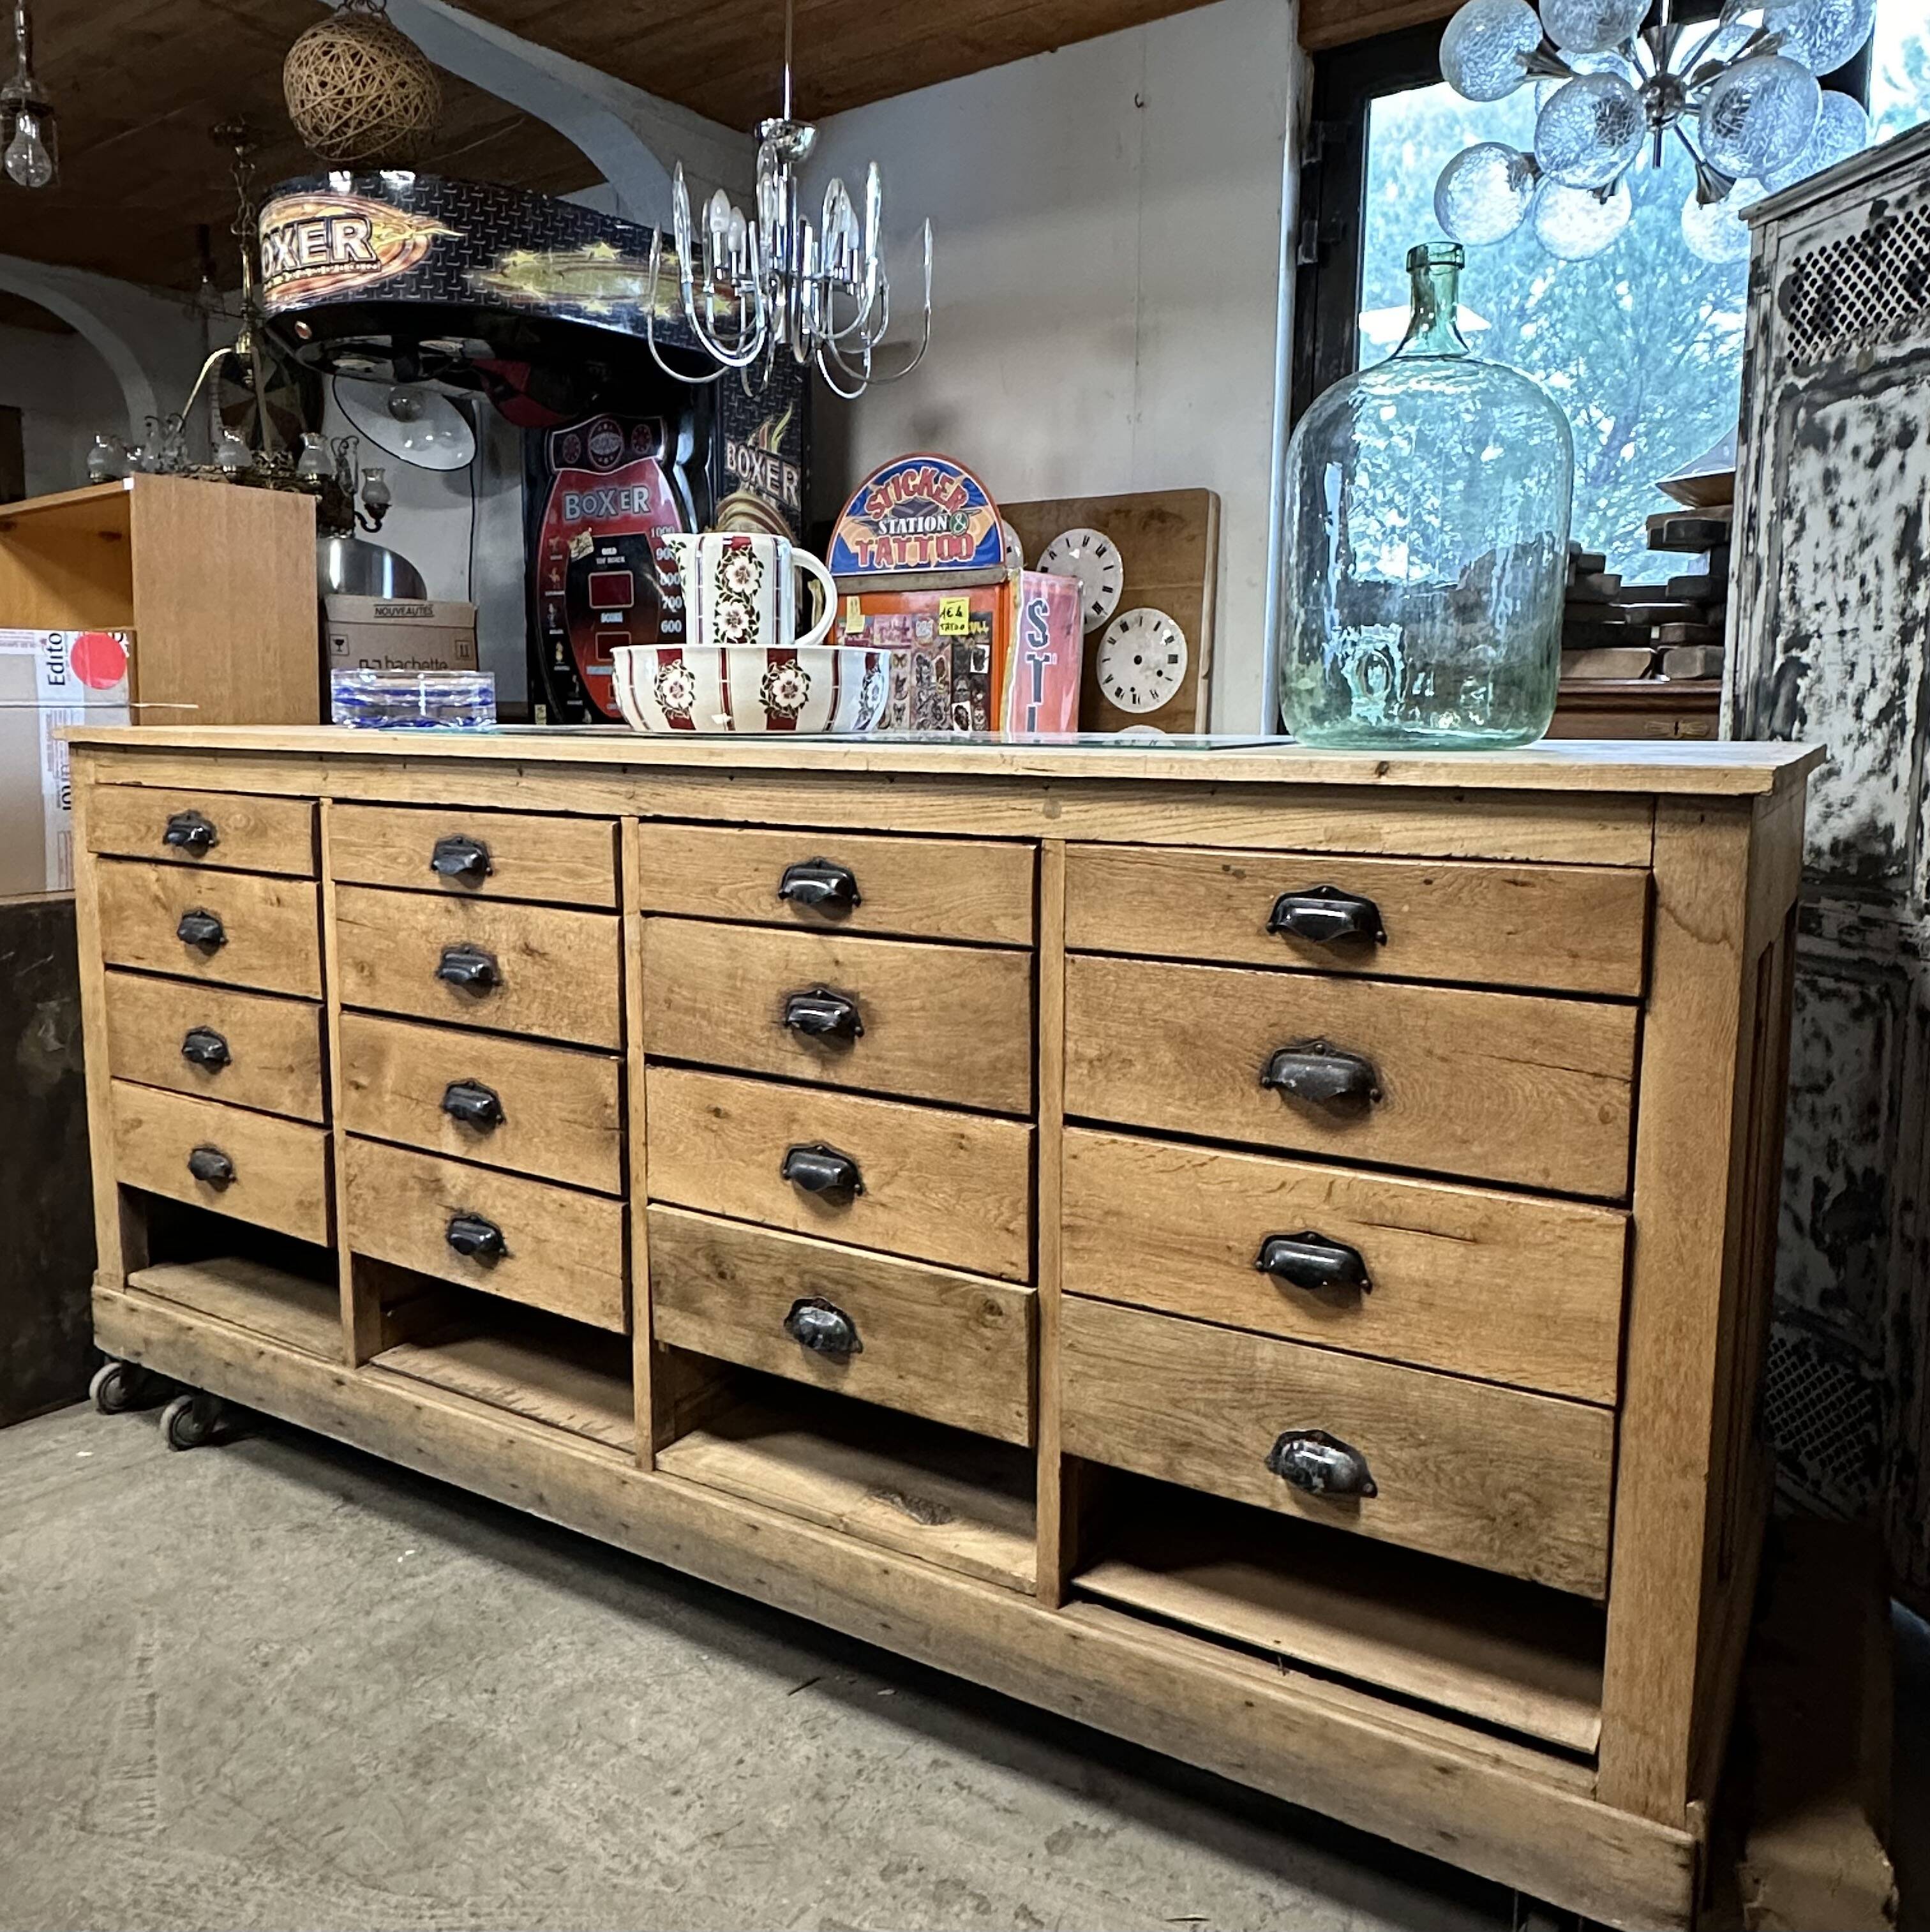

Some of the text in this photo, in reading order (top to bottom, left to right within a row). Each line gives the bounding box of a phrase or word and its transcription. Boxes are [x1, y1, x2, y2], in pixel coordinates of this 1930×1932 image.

[262, 220, 374, 280] OXER
[727, 442, 799, 507] BOXER
[564, 486, 651, 521] BOXER
[865, 467, 969, 521] STICKER
[878, 513, 966, 535] STATION &
[855, 532, 975, 567] TATTOO
[661, 620, 682, 633] 600
